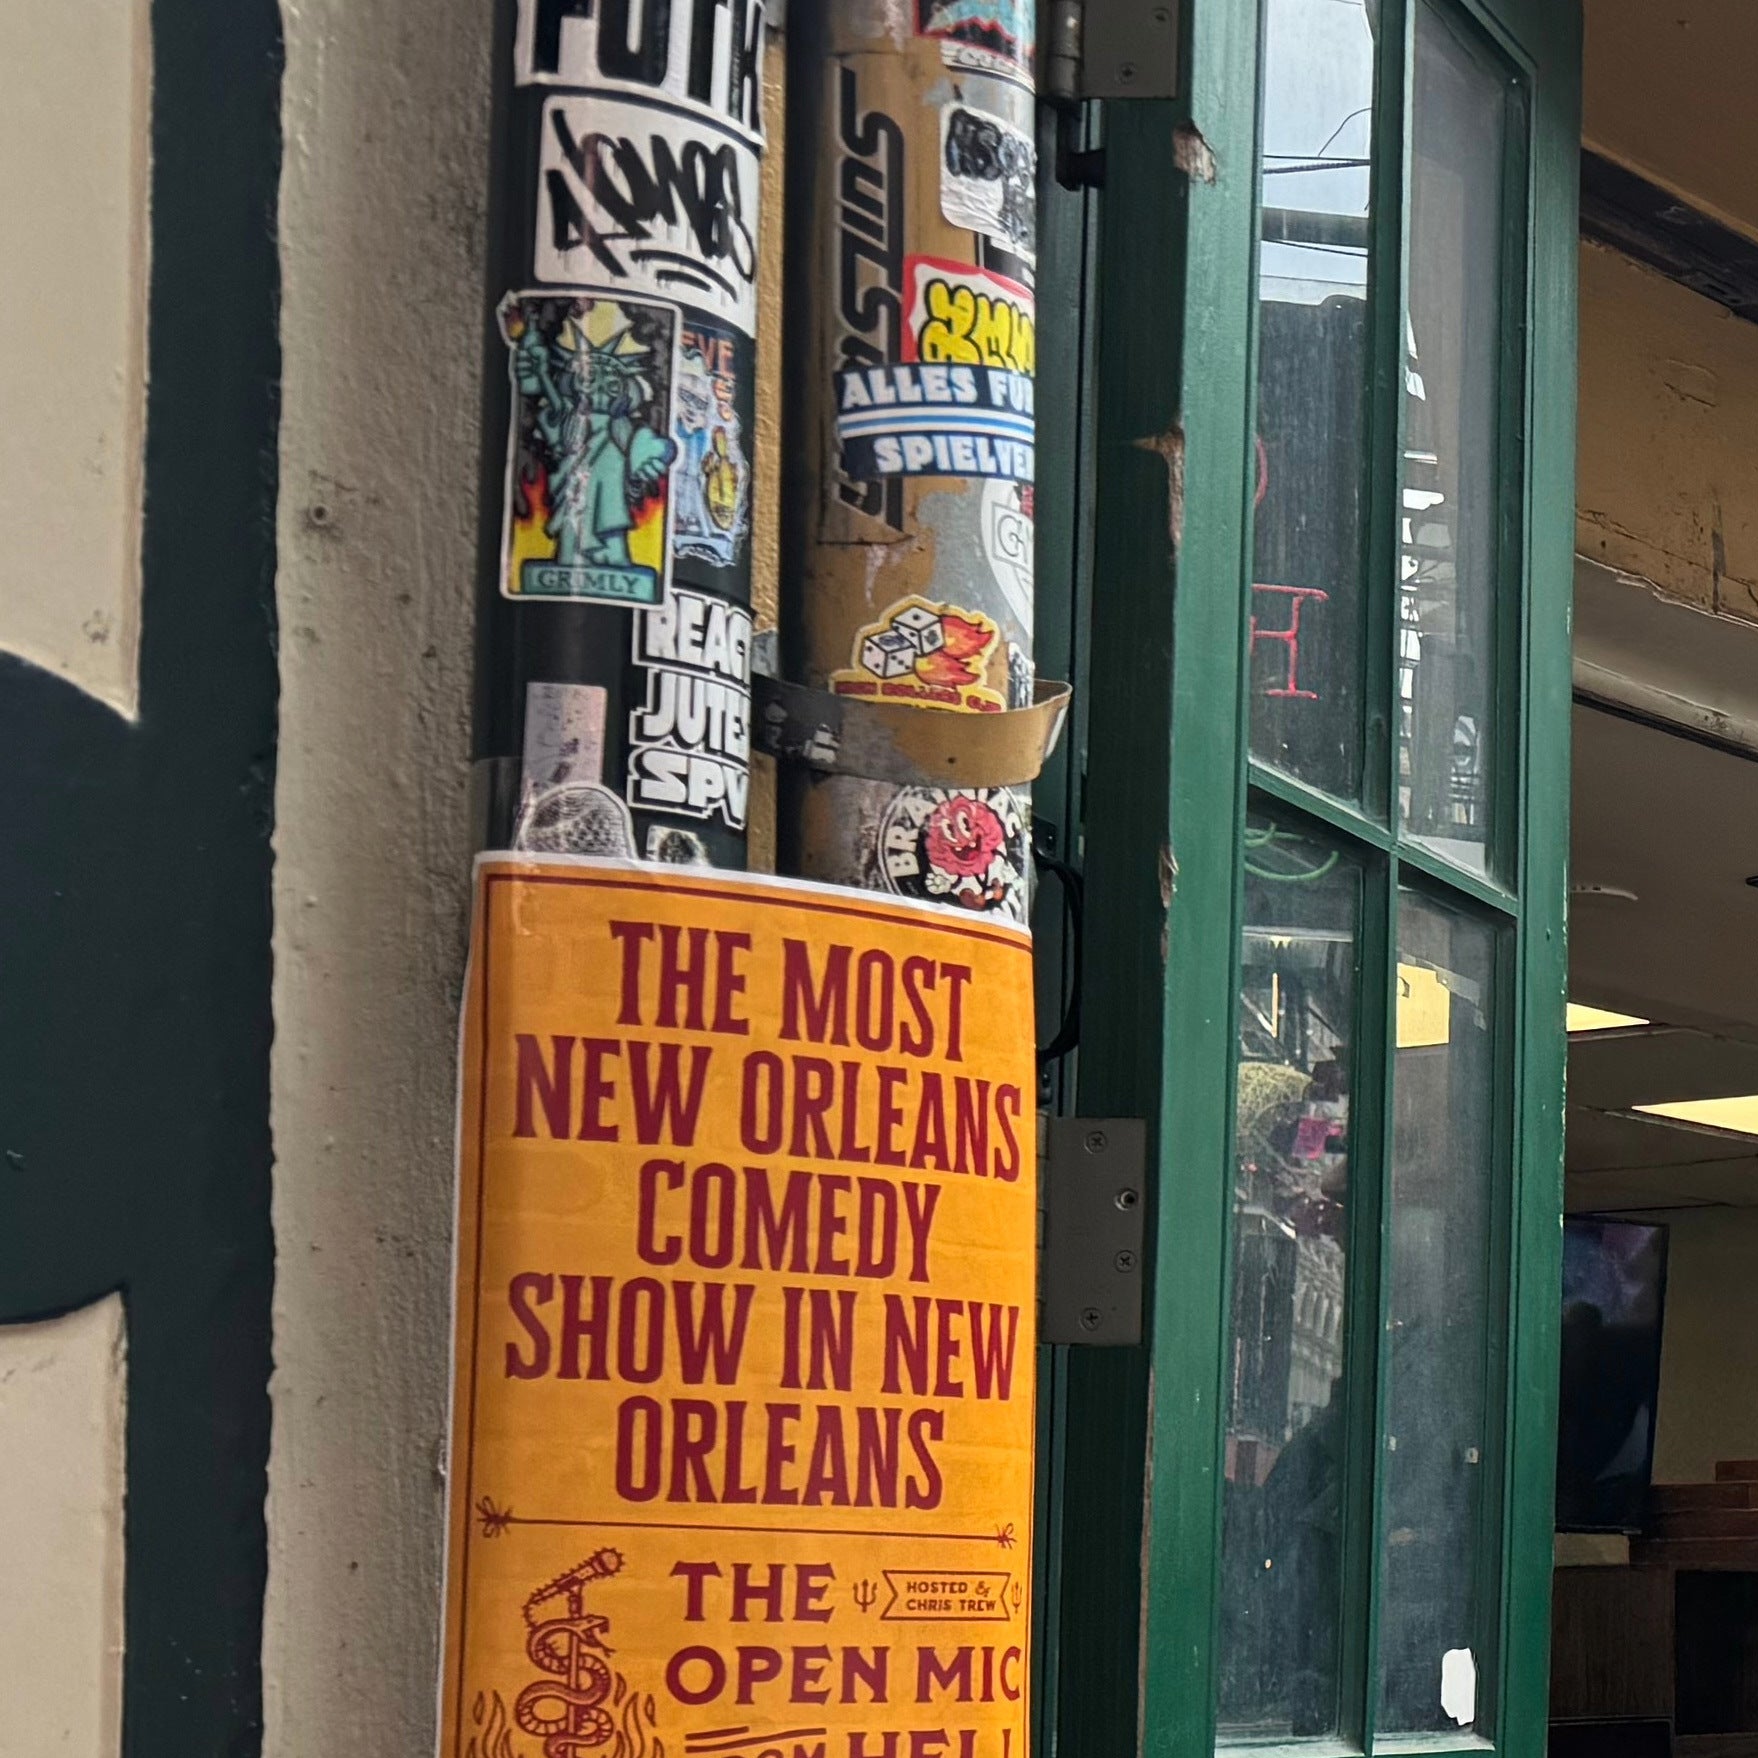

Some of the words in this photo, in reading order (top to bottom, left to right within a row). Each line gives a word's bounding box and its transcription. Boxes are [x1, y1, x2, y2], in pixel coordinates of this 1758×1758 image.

[841, 366, 977, 409] ALLES
[608, 919, 752, 1036] THE
[779, 937, 972, 1062] MOST
[512, 1033, 712, 1146] NEW
[739, 1050, 1021, 1183] ORLEANS
[636, 1158, 942, 1283] COMEDY
[504, 1272, 756, 1386] SHOW
[780, 1286, 857, 1392] IN
[880, 1294, 1020, 1401] NEW
[614, 1394, 944, 1510] ORLEANS
[669, 1561, 836, 1623] THE
[906, 1599, 952, 1612] CHRIS
[959, 1600, 996, 1612] TREW
[907, 1581, 968, 1594] HOSTED
[666, 1645, 891, 1706] OPEN
[915, 1645, 1021, 1705] MIC
